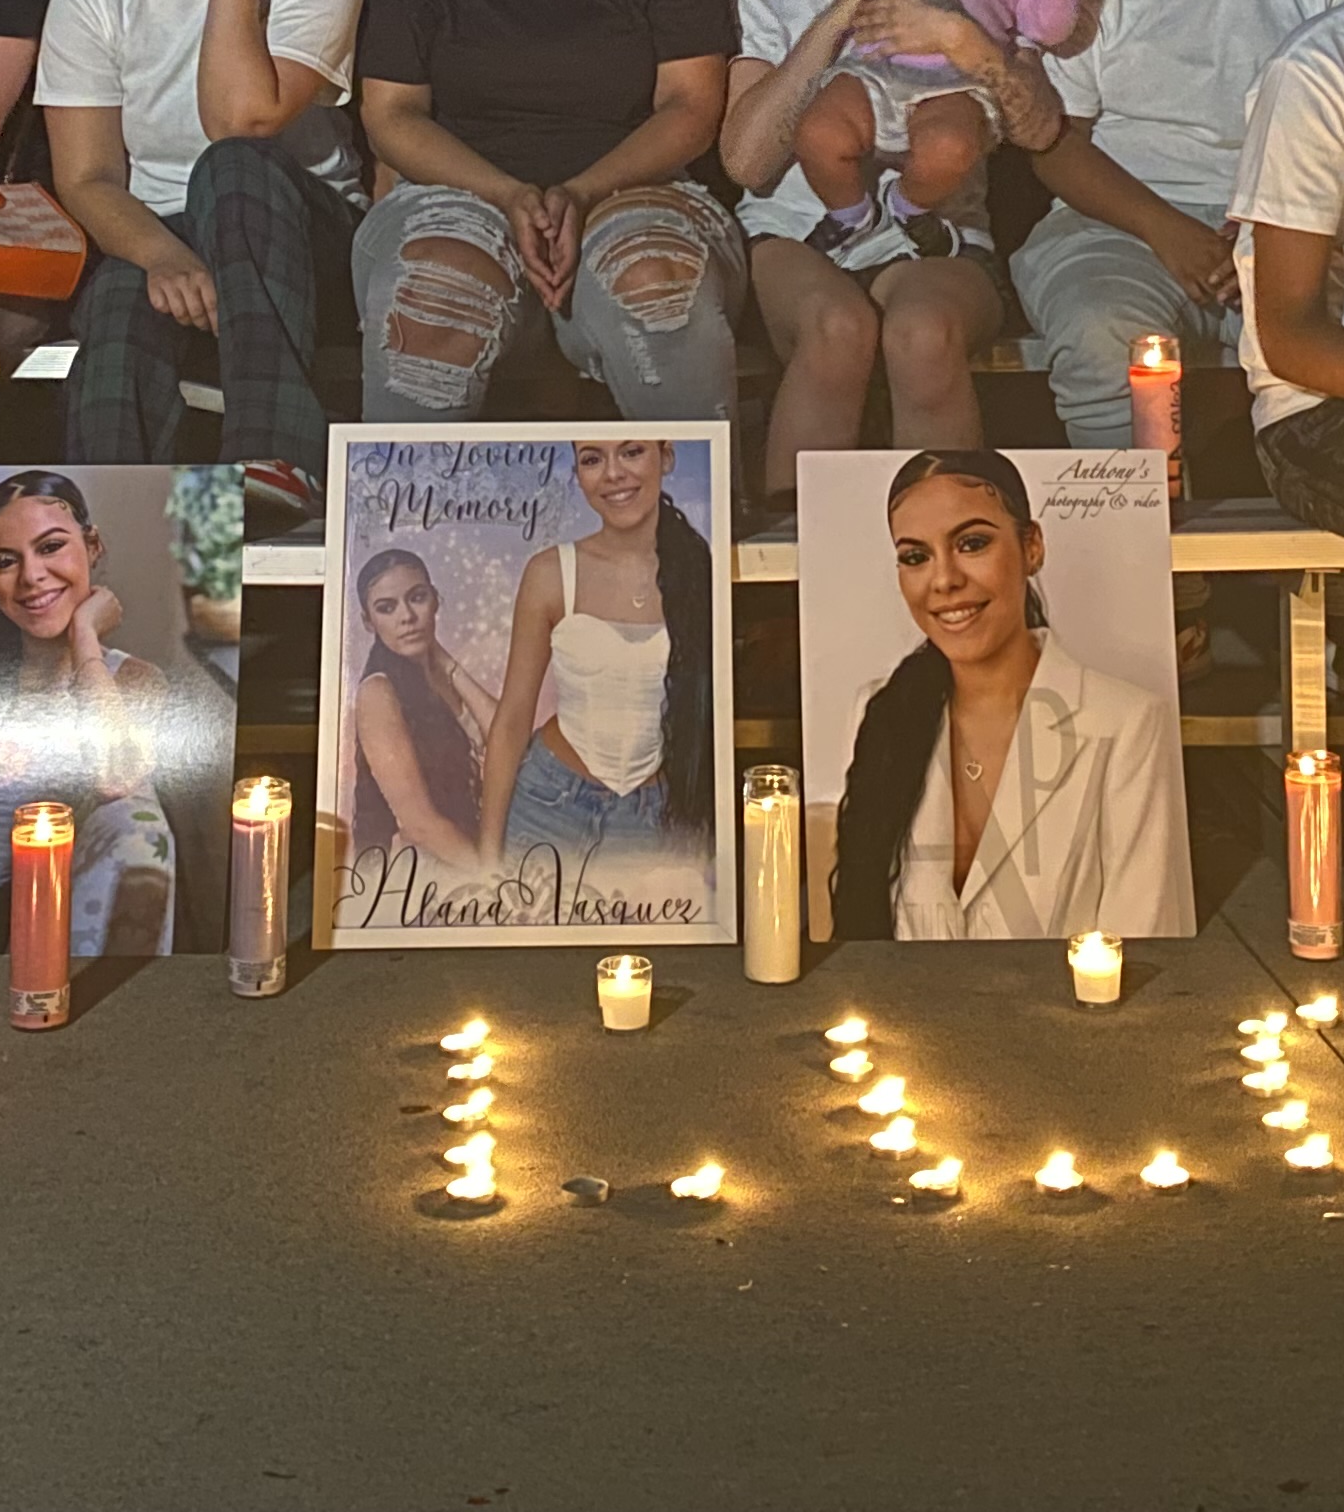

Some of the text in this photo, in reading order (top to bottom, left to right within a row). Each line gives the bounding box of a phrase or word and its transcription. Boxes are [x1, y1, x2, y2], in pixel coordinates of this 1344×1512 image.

[352, 442, 564, 486] In Loving
[1057, 449, 1150, 495] Anthony's
[364, 478, 547, 541] Memory
[1039, 486, 1106, 519] photography
[1134, 489, 1162, 509] video
[333, 838, 702, 928] Alana Vasquez
